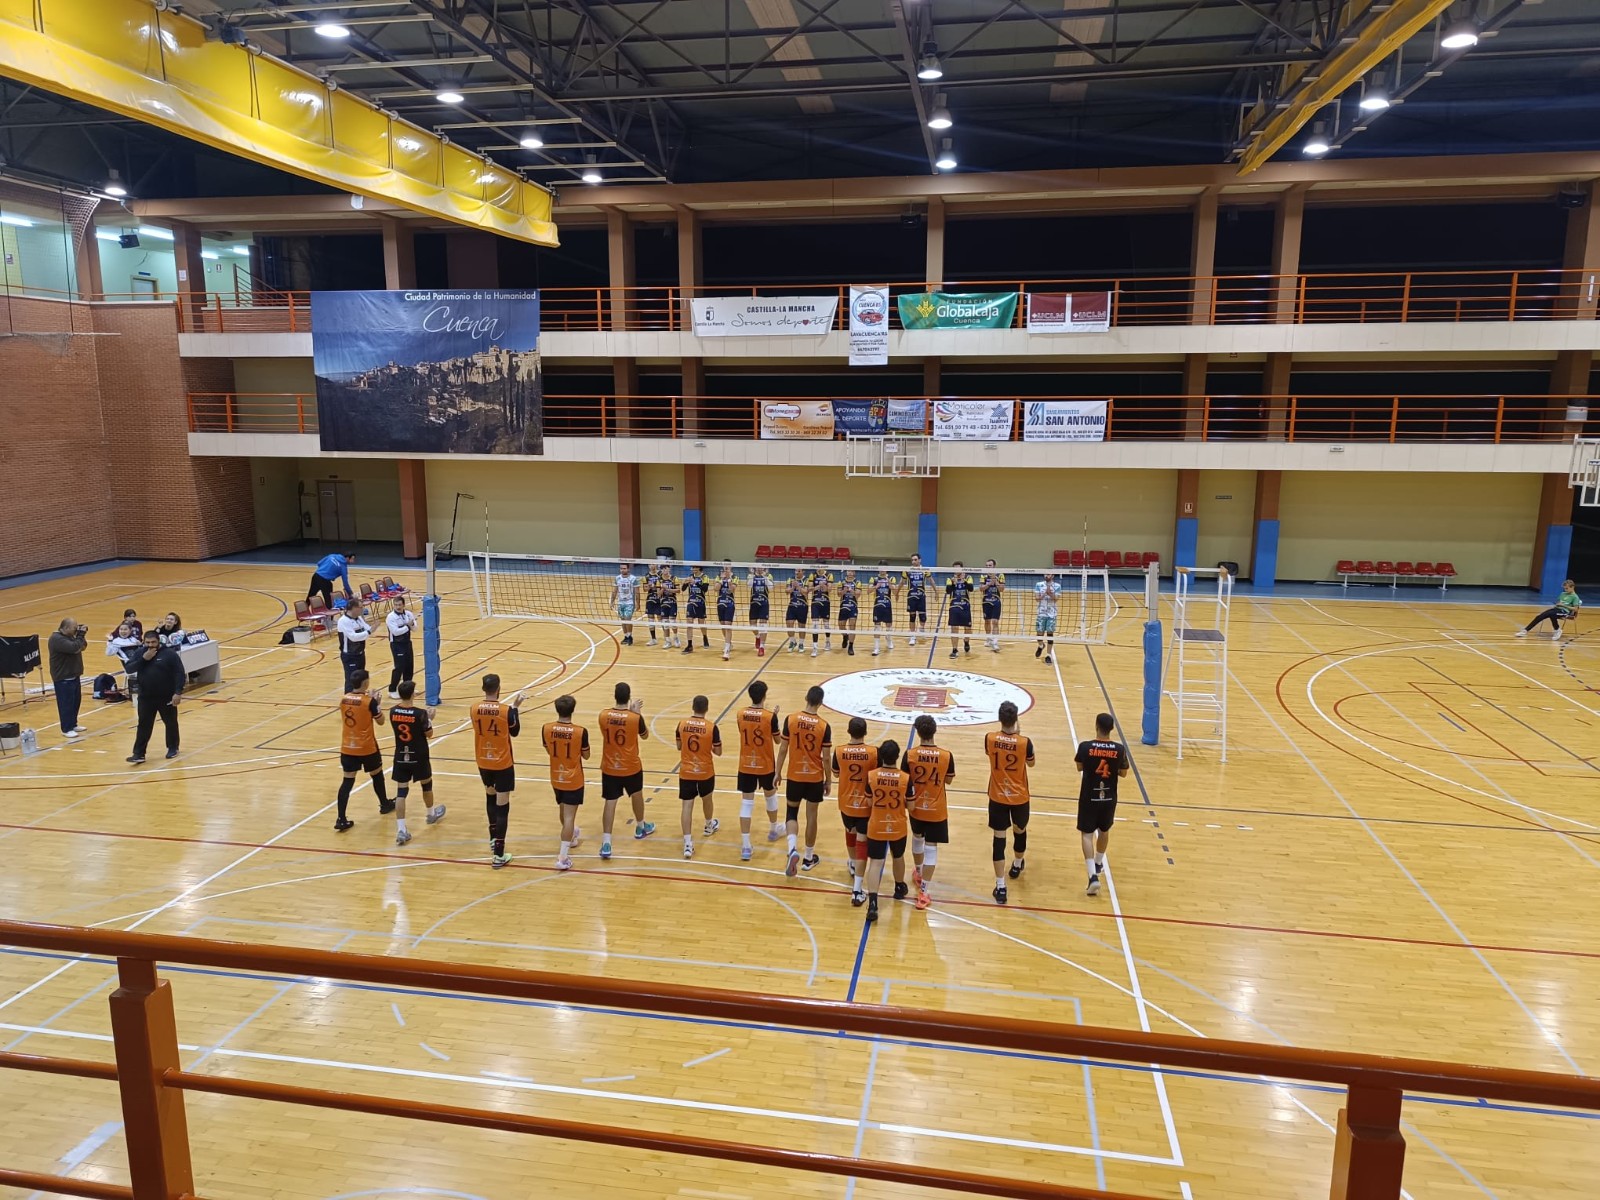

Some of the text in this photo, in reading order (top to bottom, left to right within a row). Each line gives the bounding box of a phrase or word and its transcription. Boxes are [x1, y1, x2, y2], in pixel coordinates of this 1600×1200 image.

[404, 291, 536, 301] Ciudad Patrimonio de la Humanidad
[730, 313, 772, 328] Somos
[936, 305, 999, 320] Globalcaja
[423, 306, 504, 340] Cuenca
[1046, 416, 1105, 426] SAN ANTONIO
[344, 706, 356, 728] 8
[392, 714, 415, 723] MARCOS
[477, 708, 499, 717] ALONSO
[857, 708, 882, 717] DE
[398, 724, 413, 742] 3
[476, 718, 501, 736] 14
[798, 722, 816, 731] FELIPE
[551, 731, 573, 740] TORRES
[605, 728, 626, 746] 16
[688, 735, 699, 752] 6
[743, 725, 764, 747] 18
[794, 732, 816, 752] 13
[550, 741, 571, 759] 11
[994, 741, 1016, 751] BEREZA
[1089, 747, 1118, 758] SÁNCHEZ
[918, 755, 938, 764] ANAYA
[993, 752, 1018, 772] 12
[849, 764, 863, 782] 2
[914, 766, 940, 786] 24
[1095, 759, 1111, 778] 4
[874, 789, 900, 810] 23
